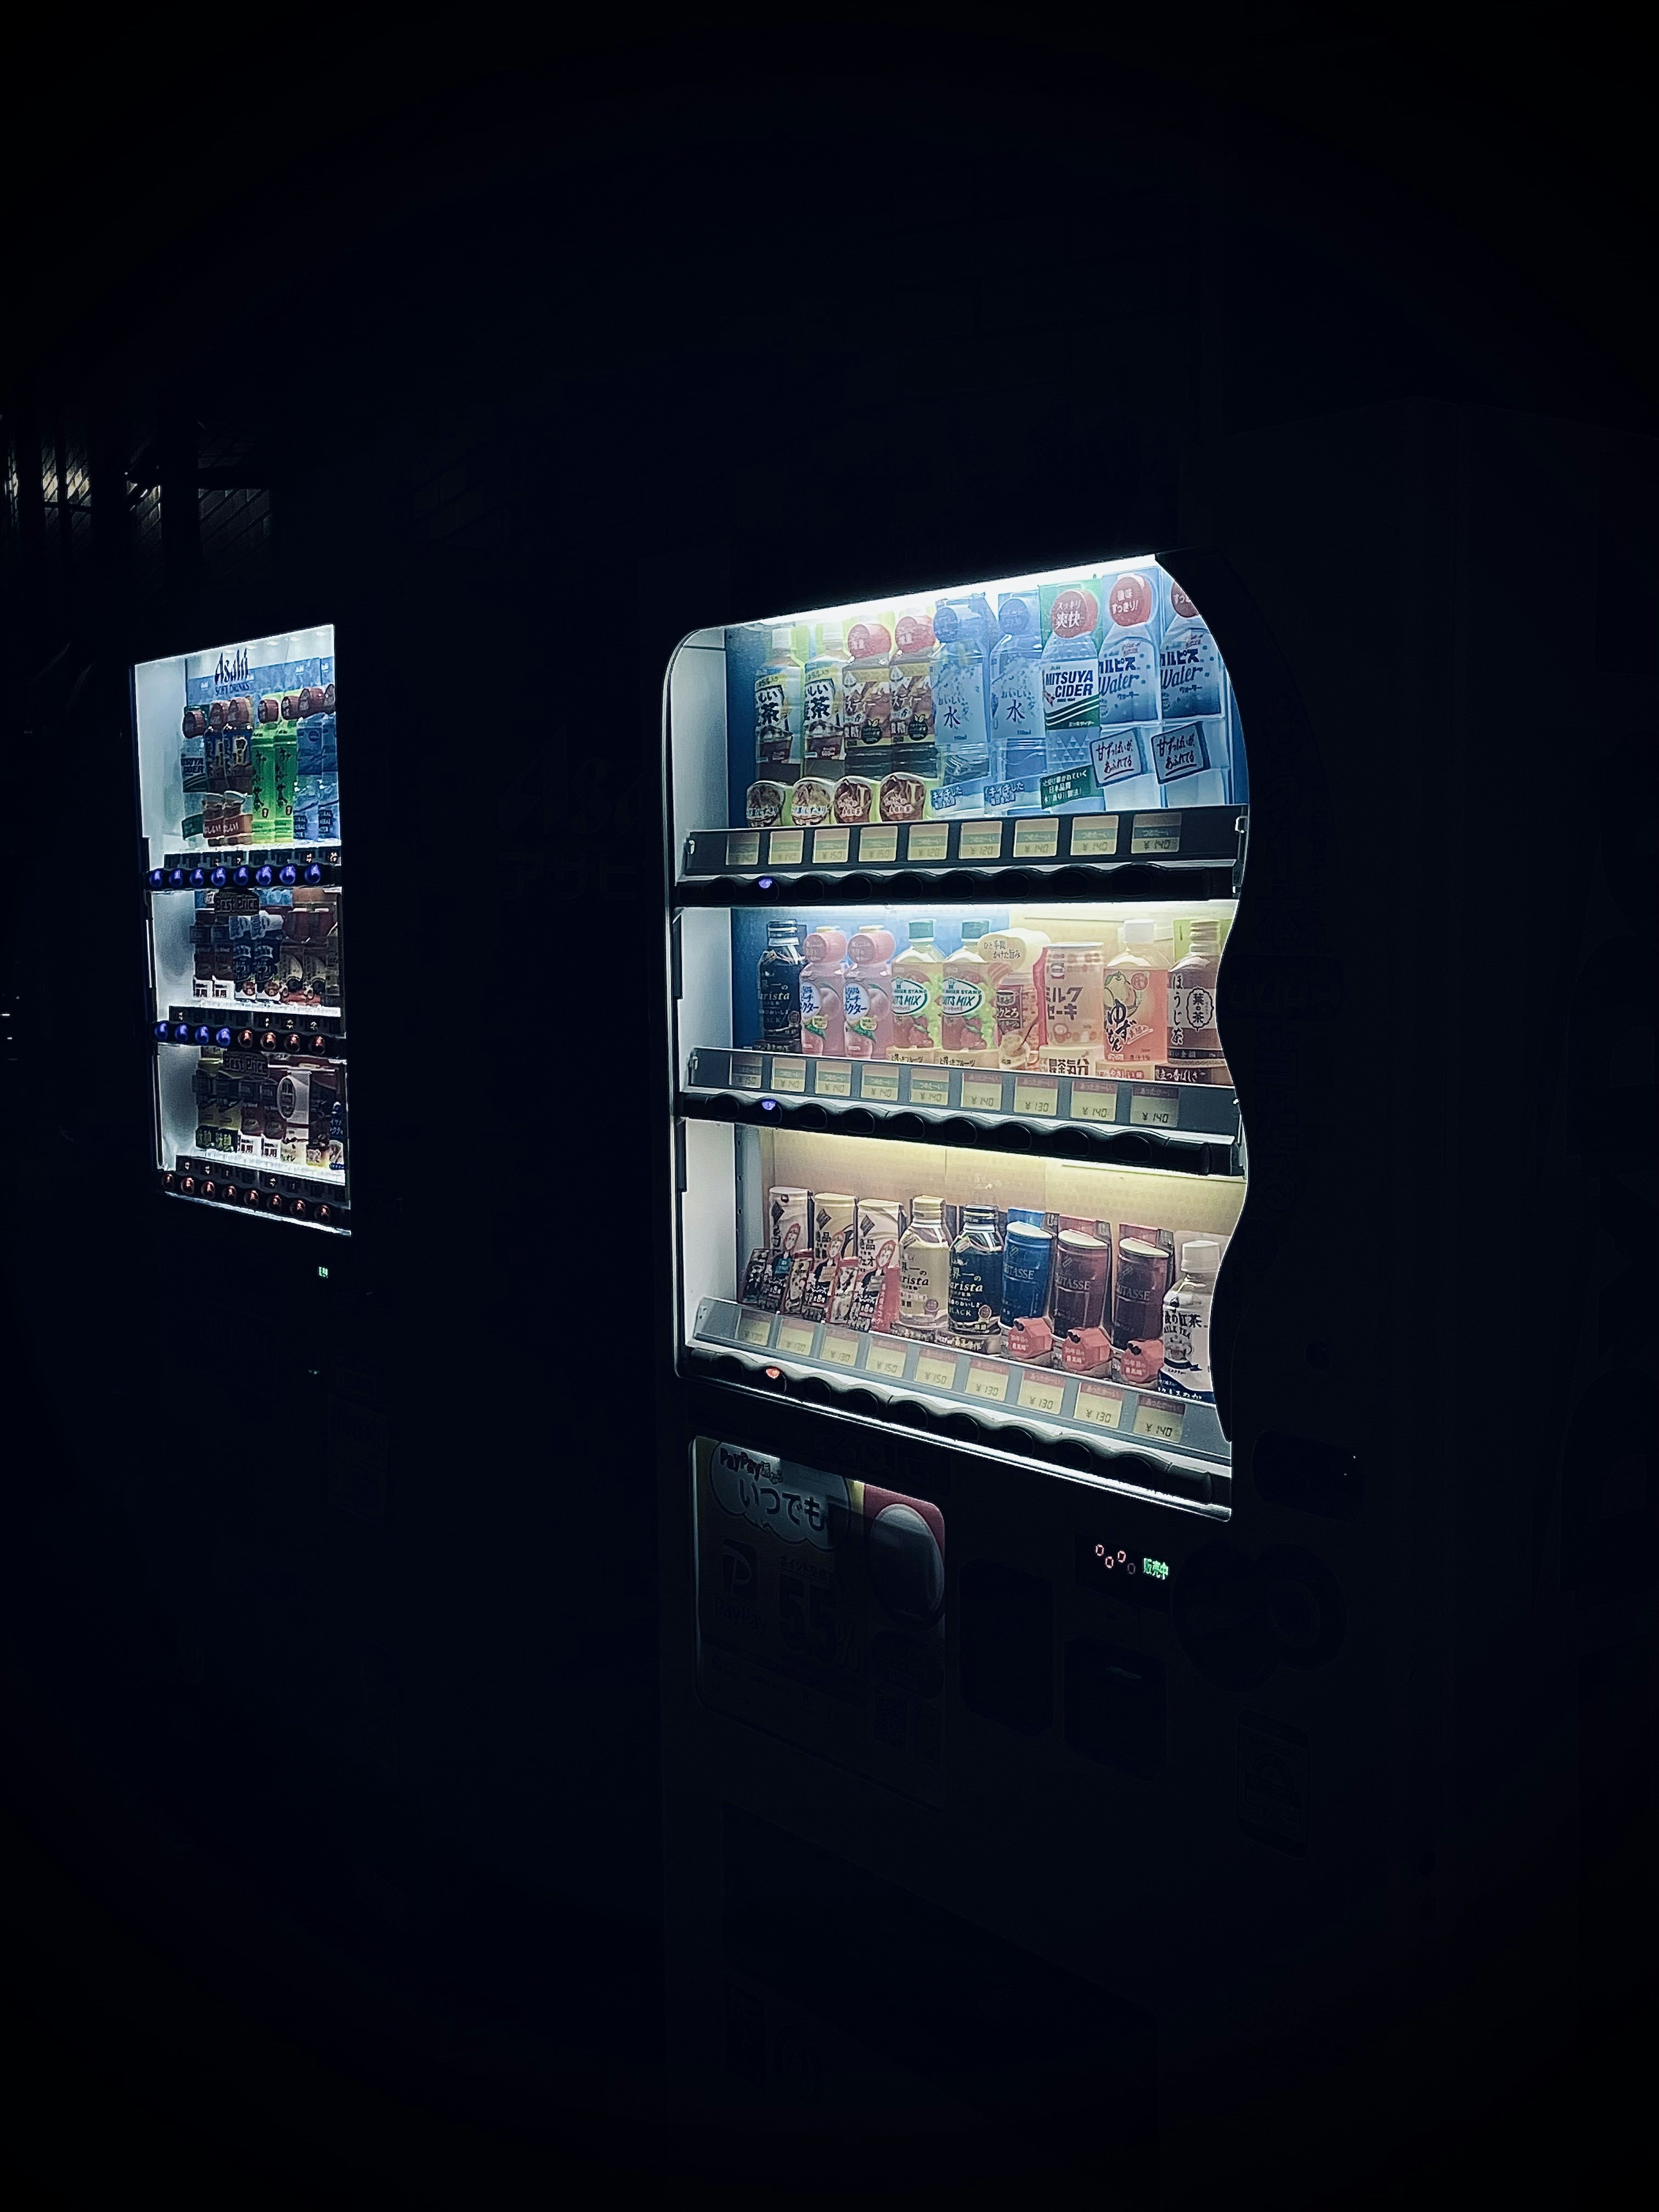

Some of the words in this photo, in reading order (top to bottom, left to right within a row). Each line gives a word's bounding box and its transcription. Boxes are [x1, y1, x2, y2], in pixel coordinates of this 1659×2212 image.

[1056, 612, 1080, 629] 爽快
[215, 648, 248, 684] Asahi
[1099, 673, 1139, 696] Water
[1161, 665, 1203, 690] Water
[1055, 684, 1093, 698] CIDER
[944, 706, 961, 727] 水
[1006, 699, 1025, 722] 水
[984, 940, 1006, 950] ひと手間
[905, 996, 922, 1006] MIX
[956, 996, 975, 1006] MIX
[1193, 993, 1204, 1023] 葉の茶
[1172, 974, 1183, 1045] ほうじ茶
[1142, 1112, 1169, 1124] ¥140
[975, 1384, 998, 1397] ¥130
[1029, 1396, 1053, 1410] ¥130
[1086, 1409, 1111, 1423] ¥130
[1146, 1423, 1172, 1437] ¥140
[740, 1479, 825, 1532] いつでも
